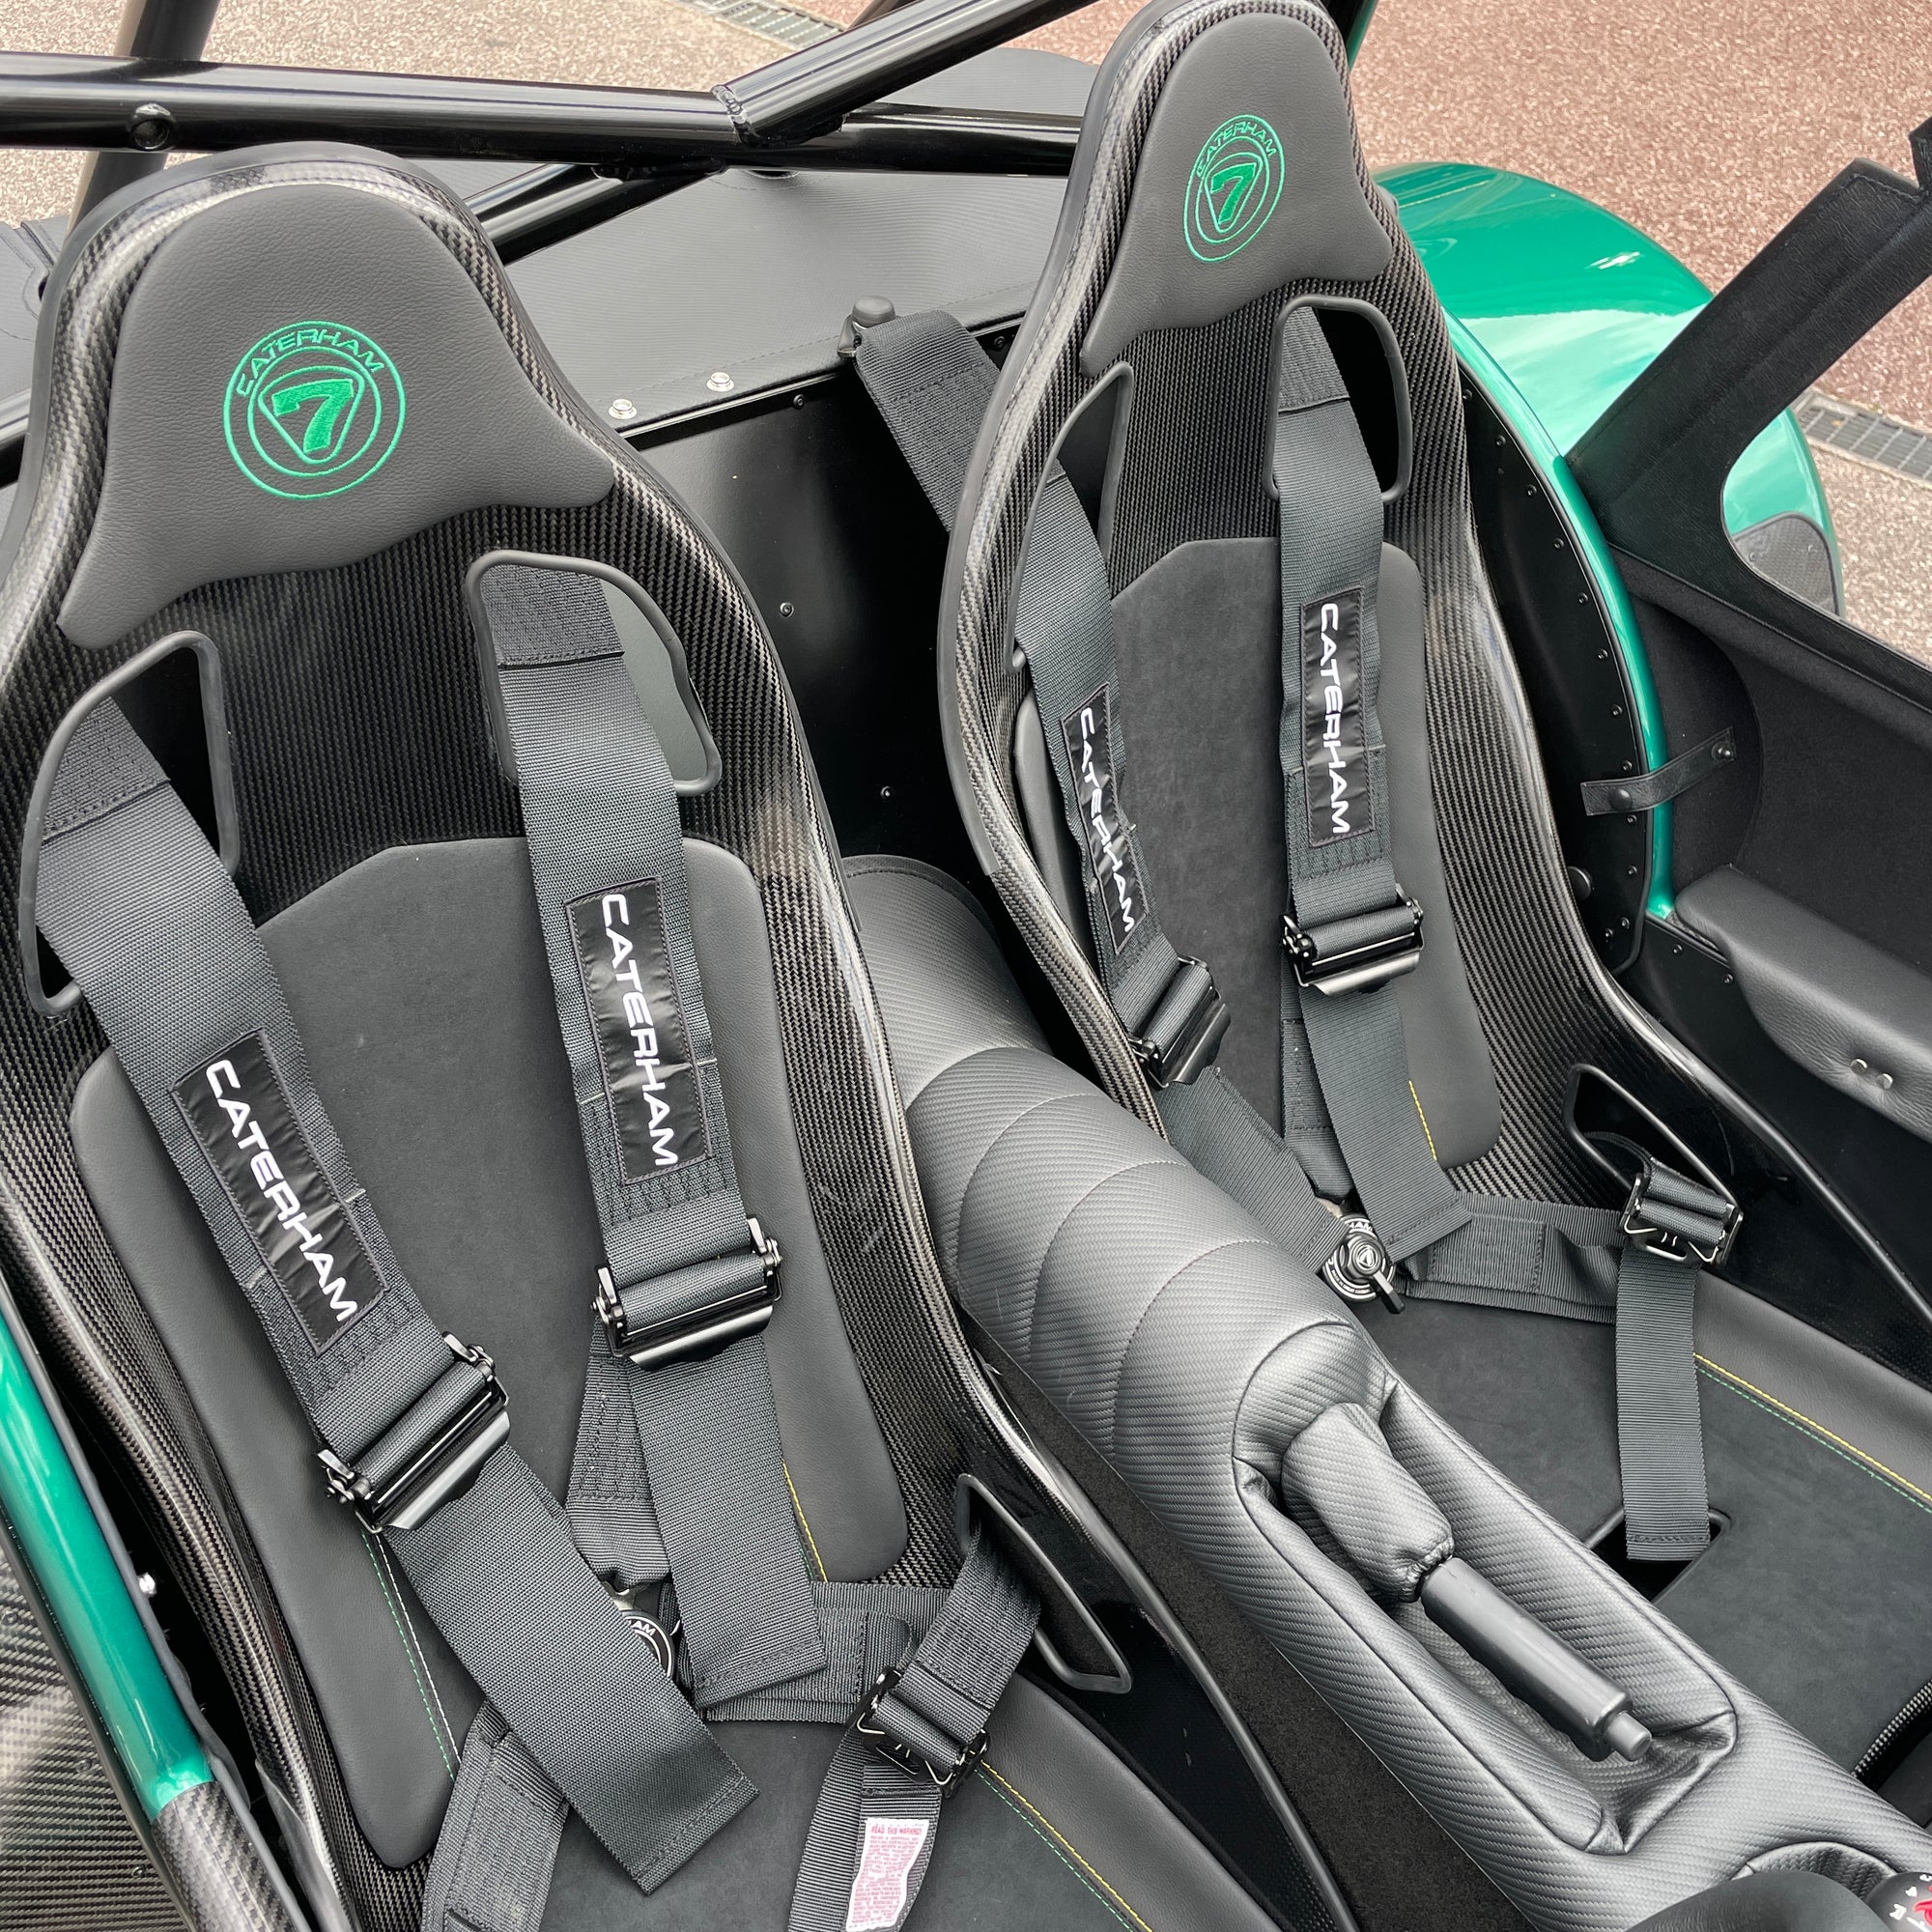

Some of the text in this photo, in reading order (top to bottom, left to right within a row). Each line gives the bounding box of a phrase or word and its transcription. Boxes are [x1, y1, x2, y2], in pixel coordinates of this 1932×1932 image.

[1196, 121, 1277, 178] CATERHAM
[1209, 161, 1257, 225] 7
[236, 327, 385, 397] CATERHAM
[270, 378, 355, 454] 7
[1320, 602, 1351, 835] CATERHAM
[1080, 706, 1135, 933] CATERHAM
[601, 893, 680, 1167] CATERHAM
[205, 1059, 358, 1323] CATERHAM
